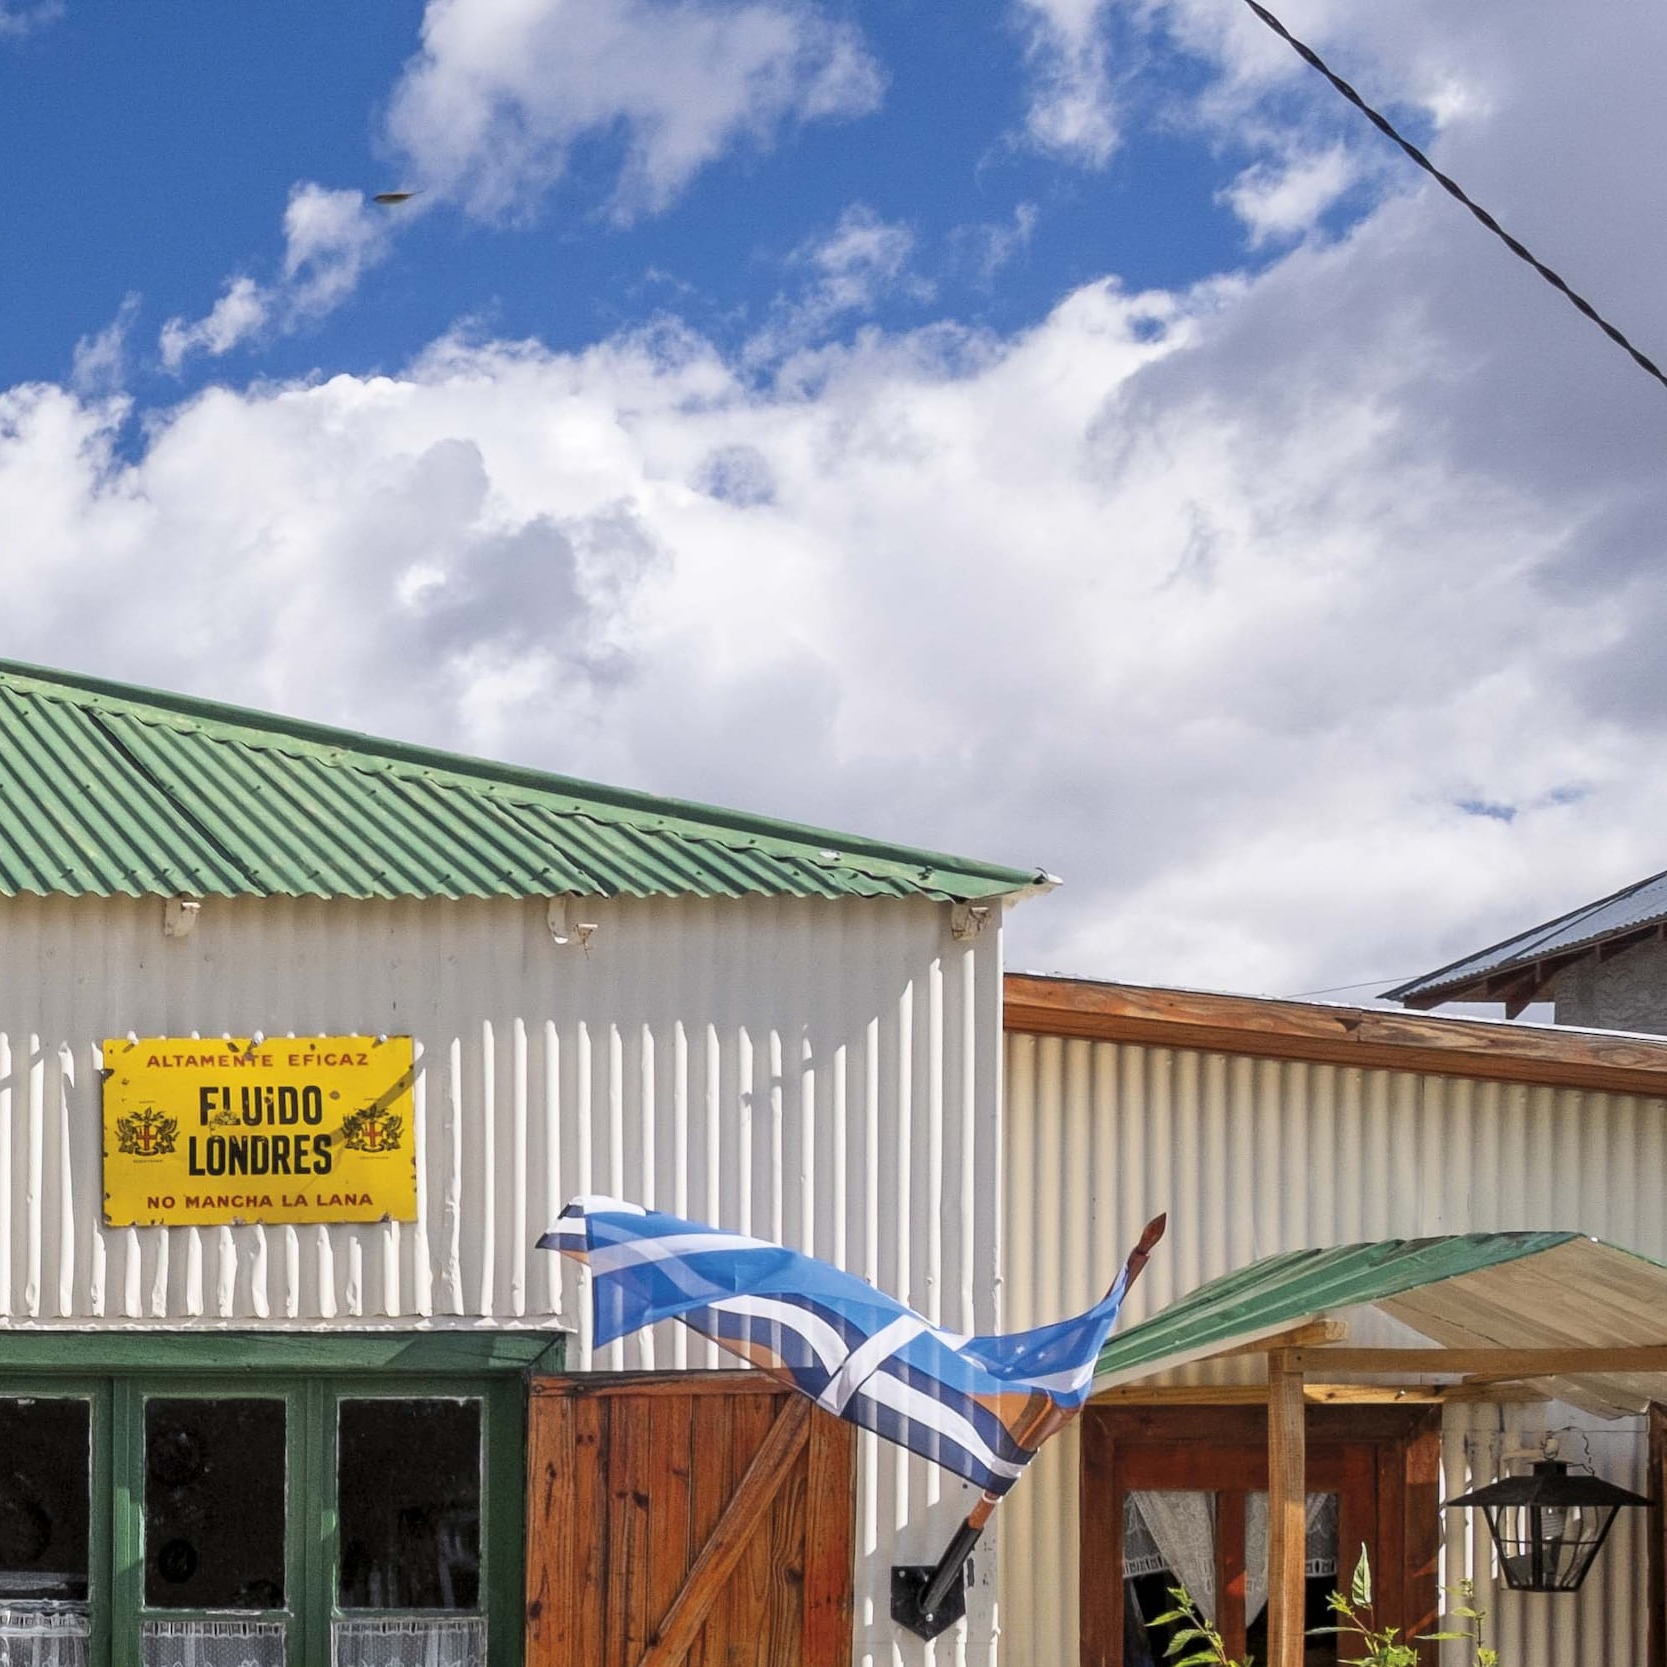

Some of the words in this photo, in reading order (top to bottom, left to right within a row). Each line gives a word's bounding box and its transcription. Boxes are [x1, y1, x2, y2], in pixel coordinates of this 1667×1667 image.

[146, 1053, 274, 1068] ALTAMENTE
[288, 1053, 369, 1067] EFICAZ
[199, 1085, 323, 1127] FLUIDO
[188, 1133, 332, 1177] LONDRES
[147, 1196, 176, 1210] NO
[185, 1194, 273, 1209] MANCHA
[282, 1193, 309, 1208] LA
[316, 1192, 373, 1207] LANA
